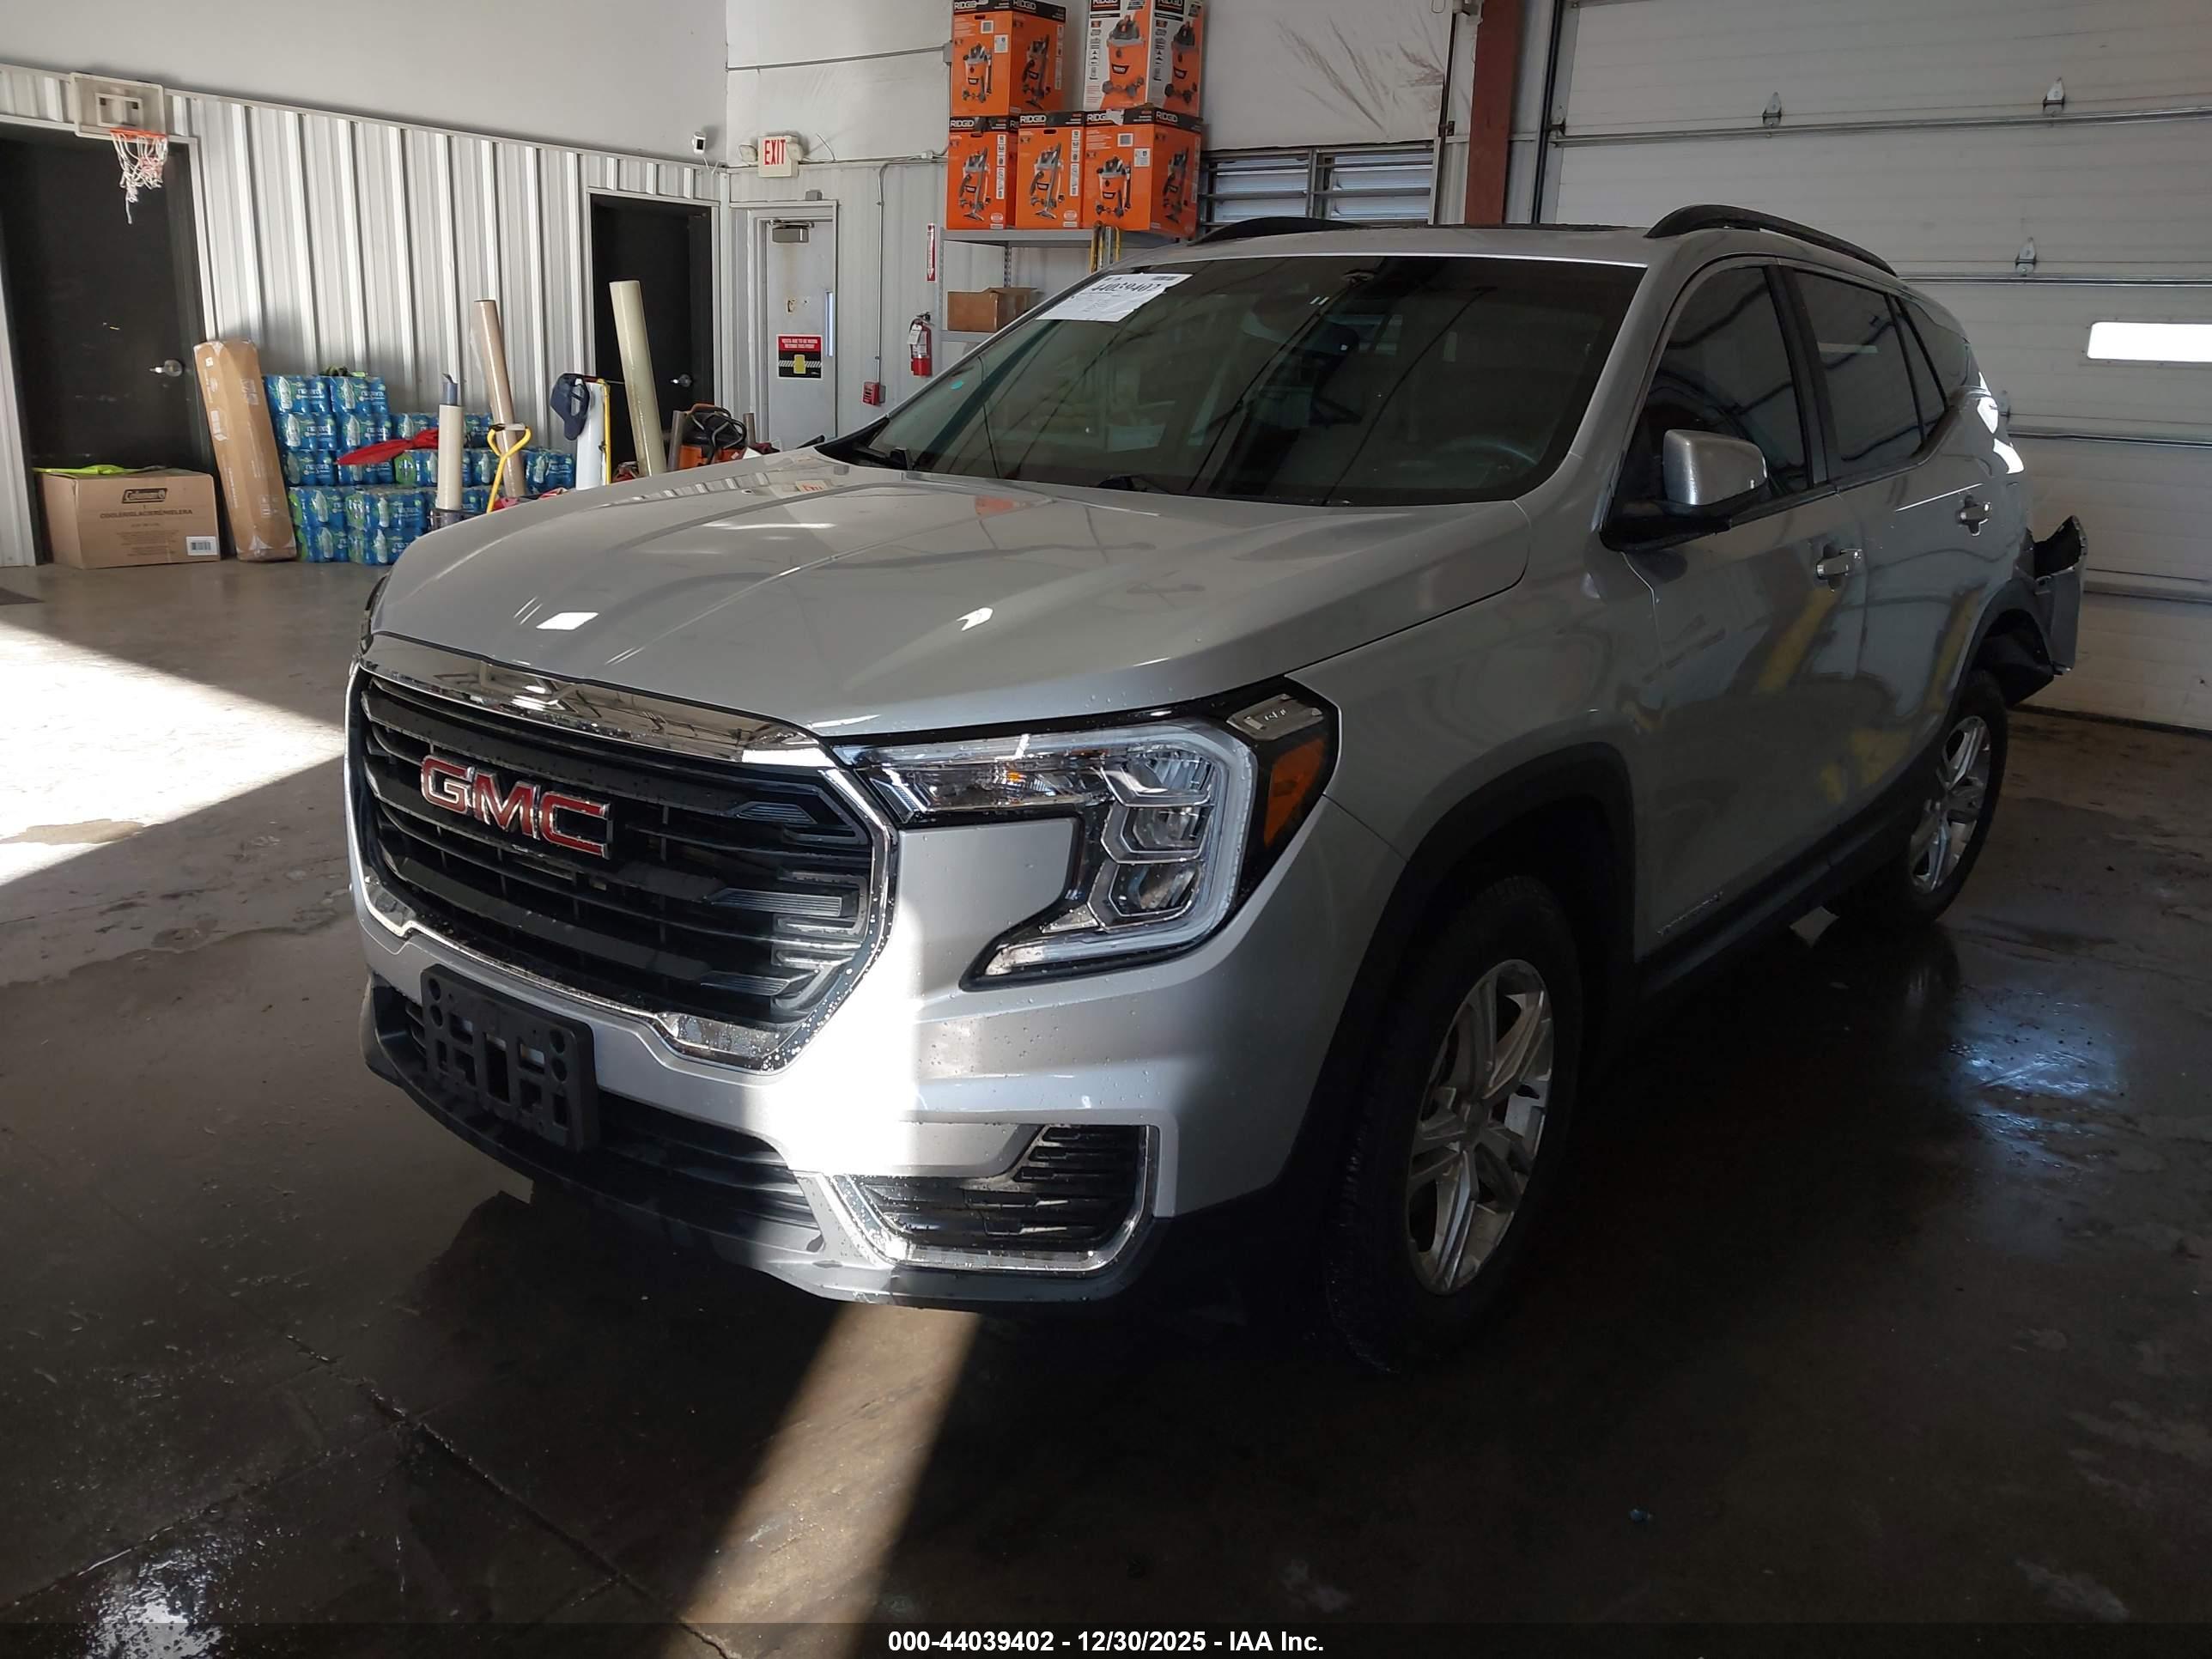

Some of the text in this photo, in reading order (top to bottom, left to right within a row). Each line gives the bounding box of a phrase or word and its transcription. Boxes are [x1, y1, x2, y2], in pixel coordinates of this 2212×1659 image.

[1019, 115, 1047, 124] RIDGID
[1086, 113, 1106, 122] RIDG
[1156, 111, 1178, 123] RIDGID
[764, 139, 786, 165] EXIT
[421, 755, 611, 859] GMC
